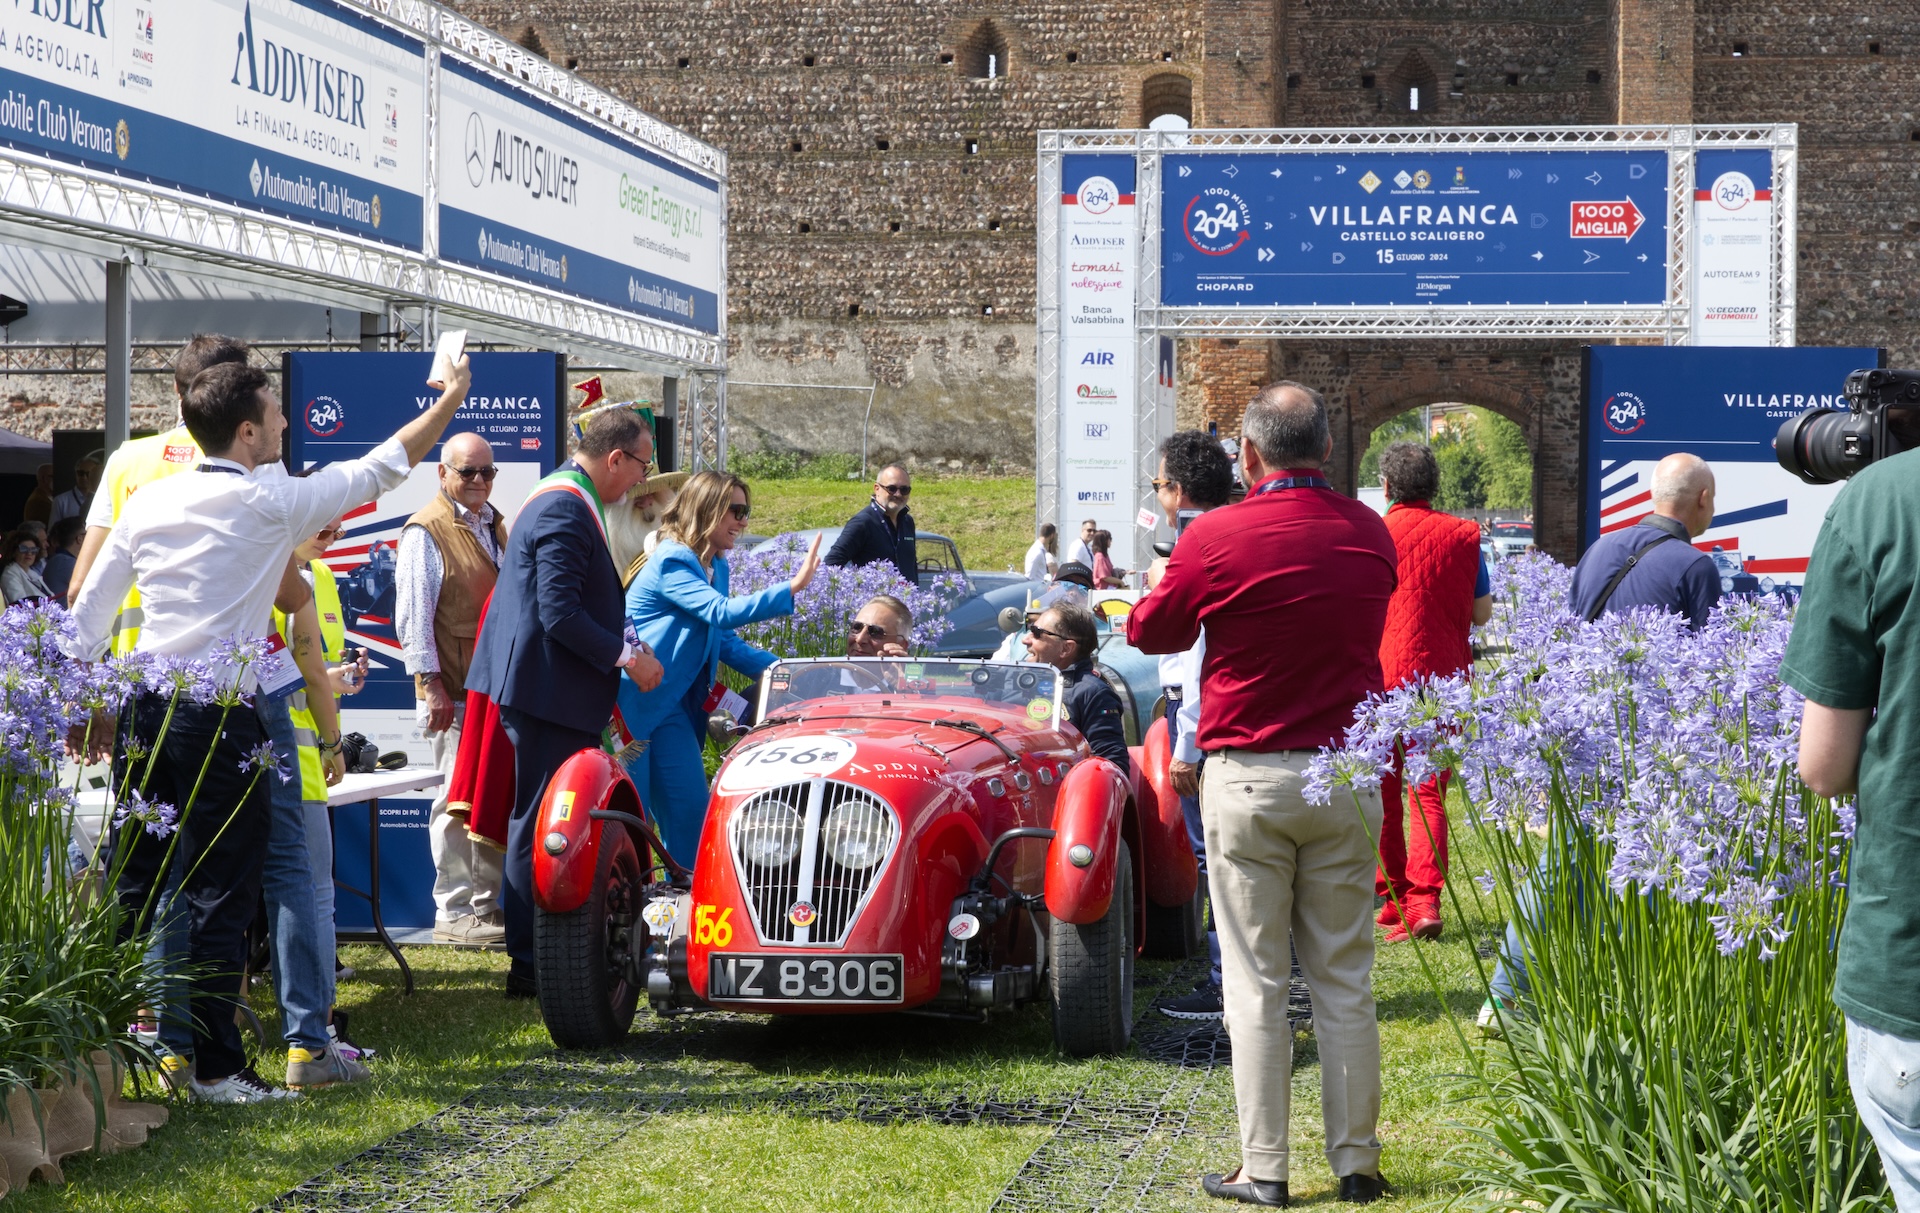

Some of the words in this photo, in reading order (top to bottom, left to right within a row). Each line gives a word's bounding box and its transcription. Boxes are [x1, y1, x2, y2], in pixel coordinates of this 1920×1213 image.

[14, 33, 100, 80] AGEVOLATA
[231, 0, 366, 130] ADDVISER
[0, 90, 34, 133] obile
[38, 99, 67, 142] Club
[69, 108, 113, 154] Verona
[236, 105, 249, 128] LA
[254, 111, 299, 144] FINANZA
[303, 129, 361, 163] AGEVOLATA
[491, 129, 579, 207] AUTOSILVER
[263, 166, 317, 209] Automobile
[319, 181, 340, 216] Club
[340, 187, 370, 223] Verona
[1086, 188, 1109, 206] 2024
[1721, 183, 1744, 202] 2024
[619, 172, 649, 218] Green
[651, 185, 684, 239] Energy
[1204, 187, 1230, 197] 1000
[1231, 193, 1251, 226] MIGLIA
[1578, 205, 1625, 218] 1000
[1193, 202, 1239, 239] 2024
[1309, 205, 1519, 226] VILLAFRANCA
[1340, 231, 1407, 242] CASTELLO
[1410, 231, 1486, 241] SCALIGERO
[1575, 221, 1628, 234] MIGLIA
[1070, 233, 1125, 246] ADDVISER
[487, 233, 524, 269] Automobile
[525, 245, 539, 273] Club
[539, 249, 560, 279] Verona
[1376, 249, 1395, 264] 15
[1396, 253, 1426, 262] GIUGNO
[1429, 253, 1449, 262] 2024
[1071, 262, 1124, 272] tomasi
[1703, 270, 1753, 278] AUTOTEAM
[1755, 270, 1760, 278] 9
[1071, 276, 1123, 292] noleggiare
[1196, 283, 1254, 291] CHOPARD
[635, 280, 662, 308] Automobile
[663, 288, 673, 311] Club
[673, 291, 689, 316] Verona
[1083, 305, 1113, 314] Banca
[1071, 315, 1125, 324] Valsabbina
[415, 396, 541, 410] VIAFRANCA
[1723, 393, 1851, 408] VILLAFRANC
[310, 404, 338, 427] 2024
[1610, 401, 1639, 424] 2024
[476, 425, 486, 433] 15
[489, 425, 519, 433] GIUGNO
[522, 425, 542, 433] 2024
[163, 453, 192, 463] MIGLIA
[167, 446, 192, 455] 1000
[744, 746, 822, 767] 156
[694, 904, 734, 948] 156
[714, 958, 764, 996] MZ
[779, 959, 895, 997] 8306
